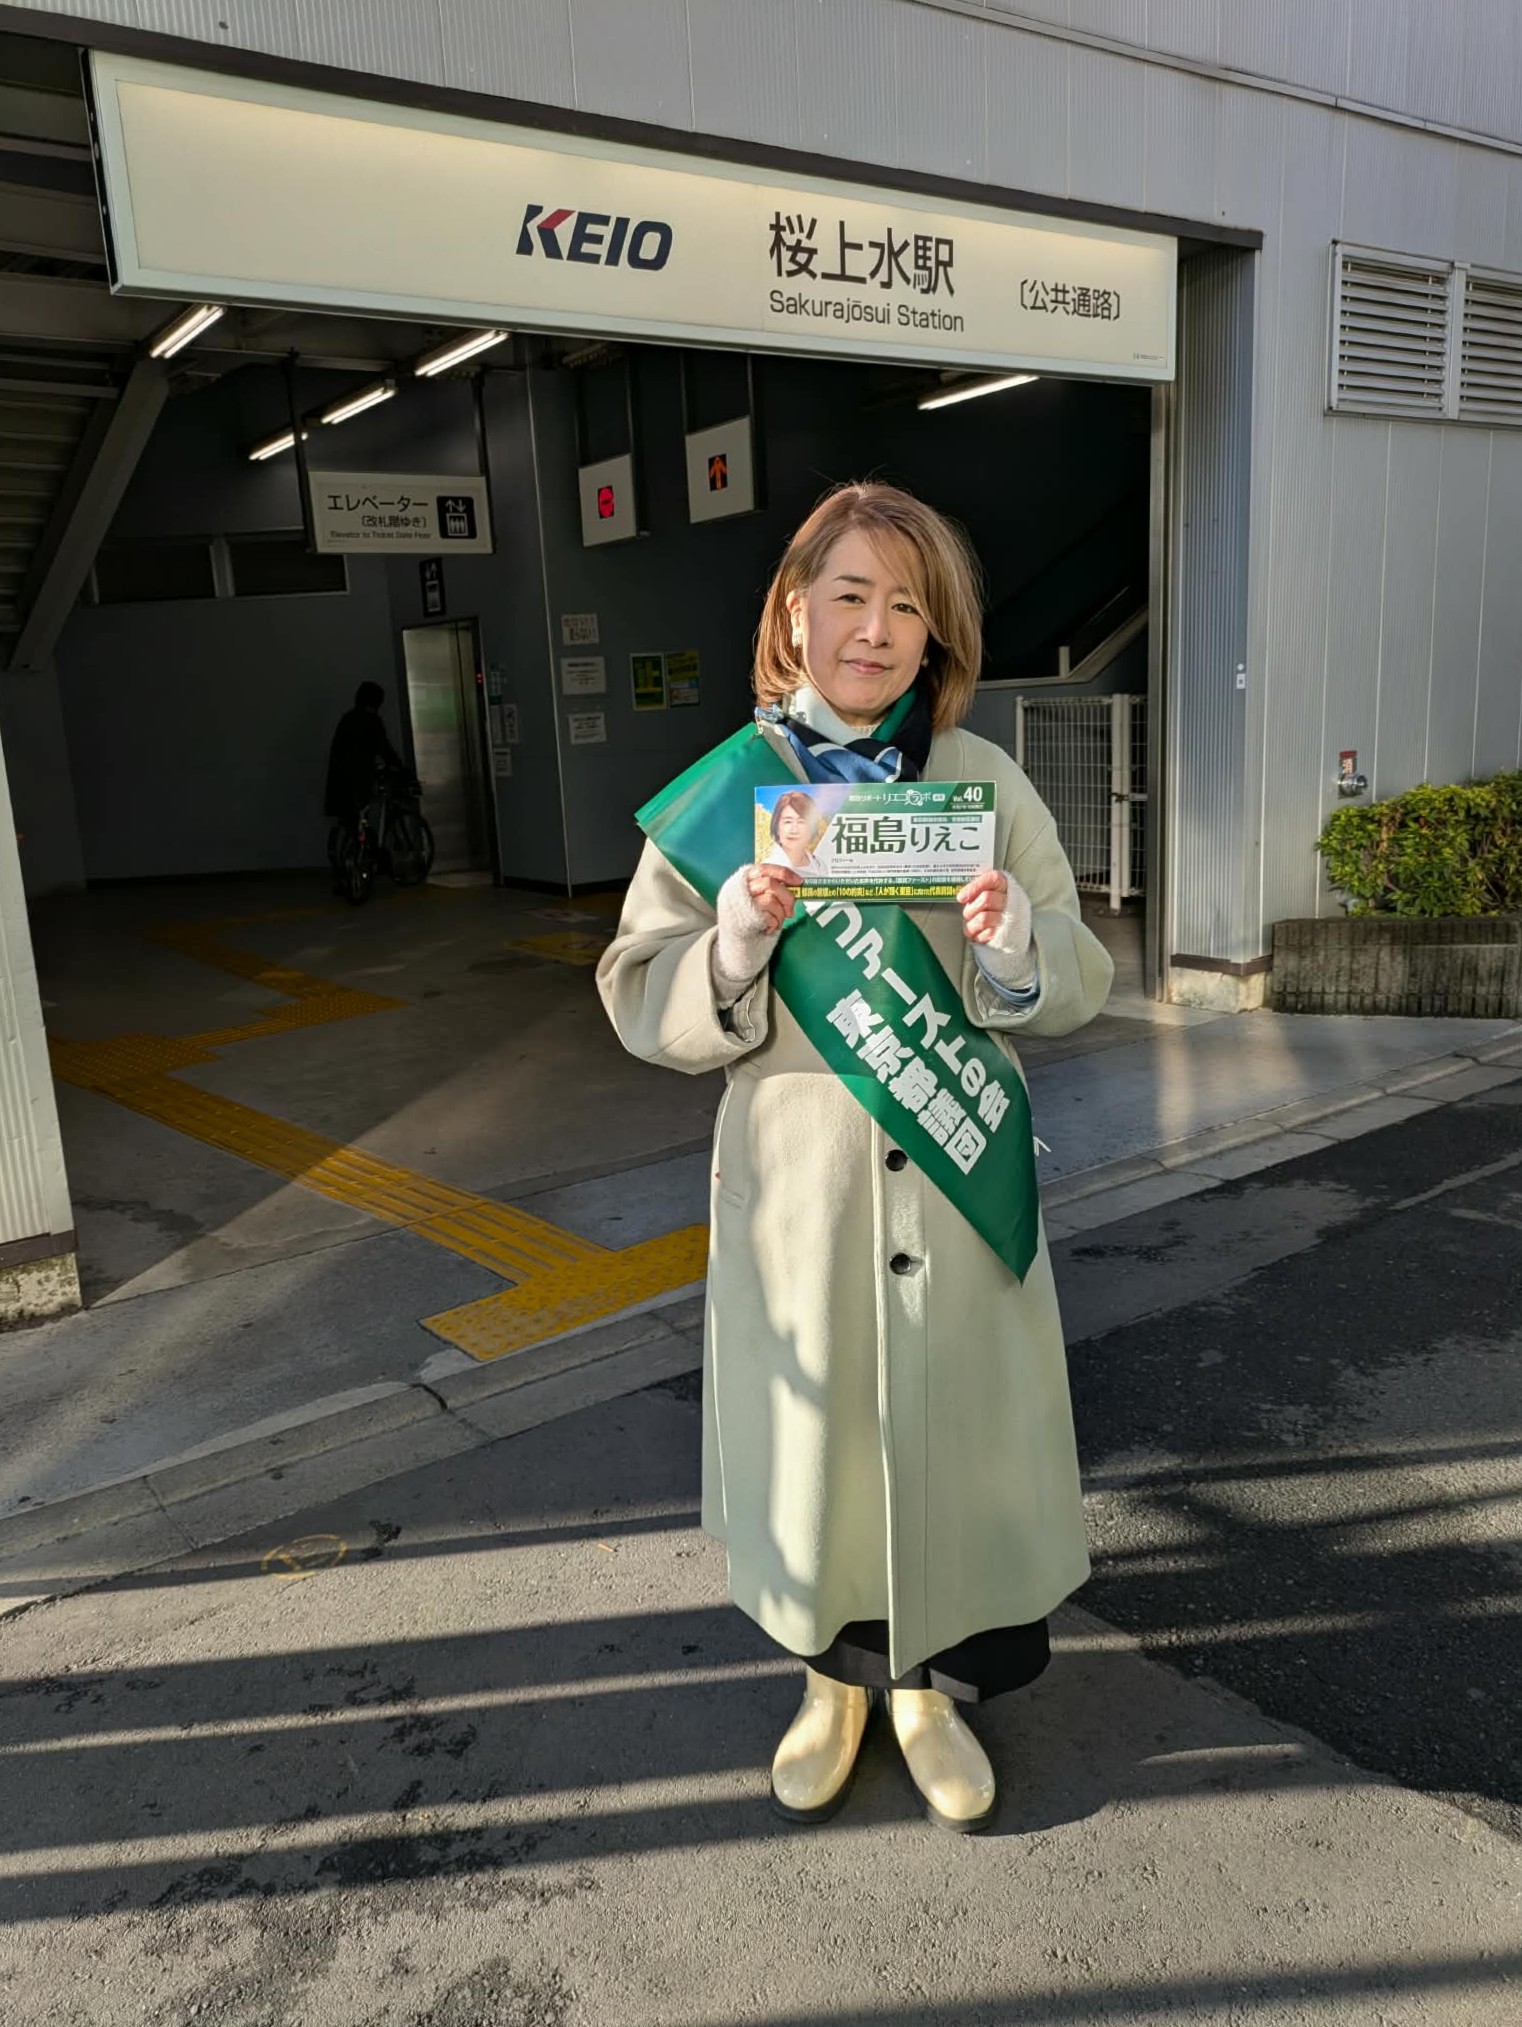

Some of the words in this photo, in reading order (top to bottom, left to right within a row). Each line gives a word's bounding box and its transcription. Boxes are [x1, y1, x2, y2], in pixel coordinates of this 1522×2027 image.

[515, 204, 673, 271] KEIO
[769, 211, 955, 297] 桜上水駅
[770, 289, 891, 325] Sakurajōsui
[897, 304, 965, 333] Station
[327, 494, 429, 512] エレベーター
[963, 786, 983, 802] 40
[831, 815, 980, 855] 福島りえこ
[803, 902, 1010, 1133] ファーストの会
[825, 988, 987, 1176] 東京都議団
